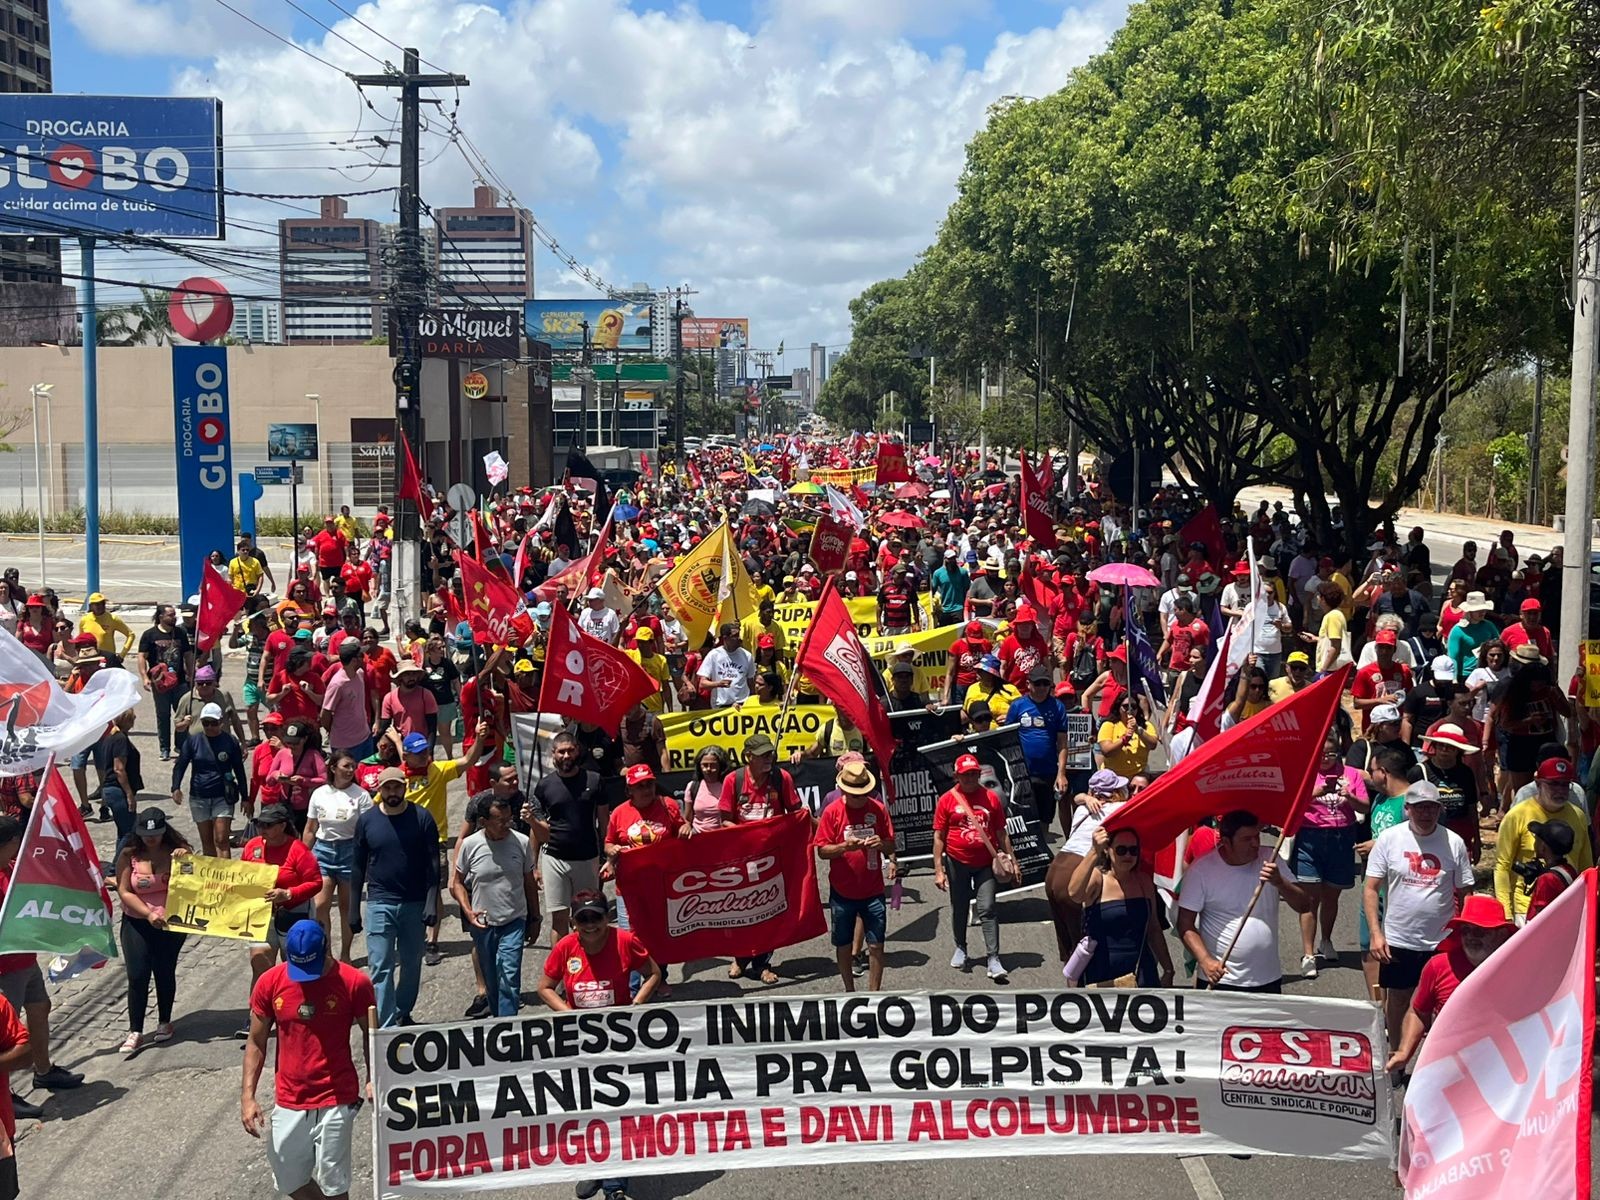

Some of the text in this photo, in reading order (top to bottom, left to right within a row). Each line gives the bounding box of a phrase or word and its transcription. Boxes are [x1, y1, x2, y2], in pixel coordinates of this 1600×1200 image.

[26, 120, 130, 137] DROGARIA
[0, 142, 190, 192] LOBO
[3, 198, 157, 213] cuidar acima de tudo
[441, 312, 514, 343] Miguel
[427, 342, 486, 353] DARIA
[183, 396, 193, 457] DROGARIA
[195, 362, 227, 490] GLOBO
[688, 708, 820, 741] OCUPAÇÃO
[1068, 724, 1088, 732] MIGO
[890, 770, 936, 798] ONGRE
[1008, 815, 1028, 835] OTTA
[672, 855, 775, 893] CSP
[670, 922, 705, 936] CENTRAL
[708, 918, 746, 927] SINDICAL
[756, 903, 787, 921] POPULAR
[677, 885, 779, 923] Conlutas
[574, 981, 611, 992] CSP
[386, 993, 1185, 1075] CONGRESSO, INIMIGO DO POVO!
[386, 1043, 1187, 1131] SEM ANISTIA PRA GOLPISTA!
[1224, 1092, 1373, 1119] CENTRAL SINDICAL E POPULAR
[388, 1094, 1202, 1187] FORA HUGO MOTTA E DAVI ALCOLUMBRE
